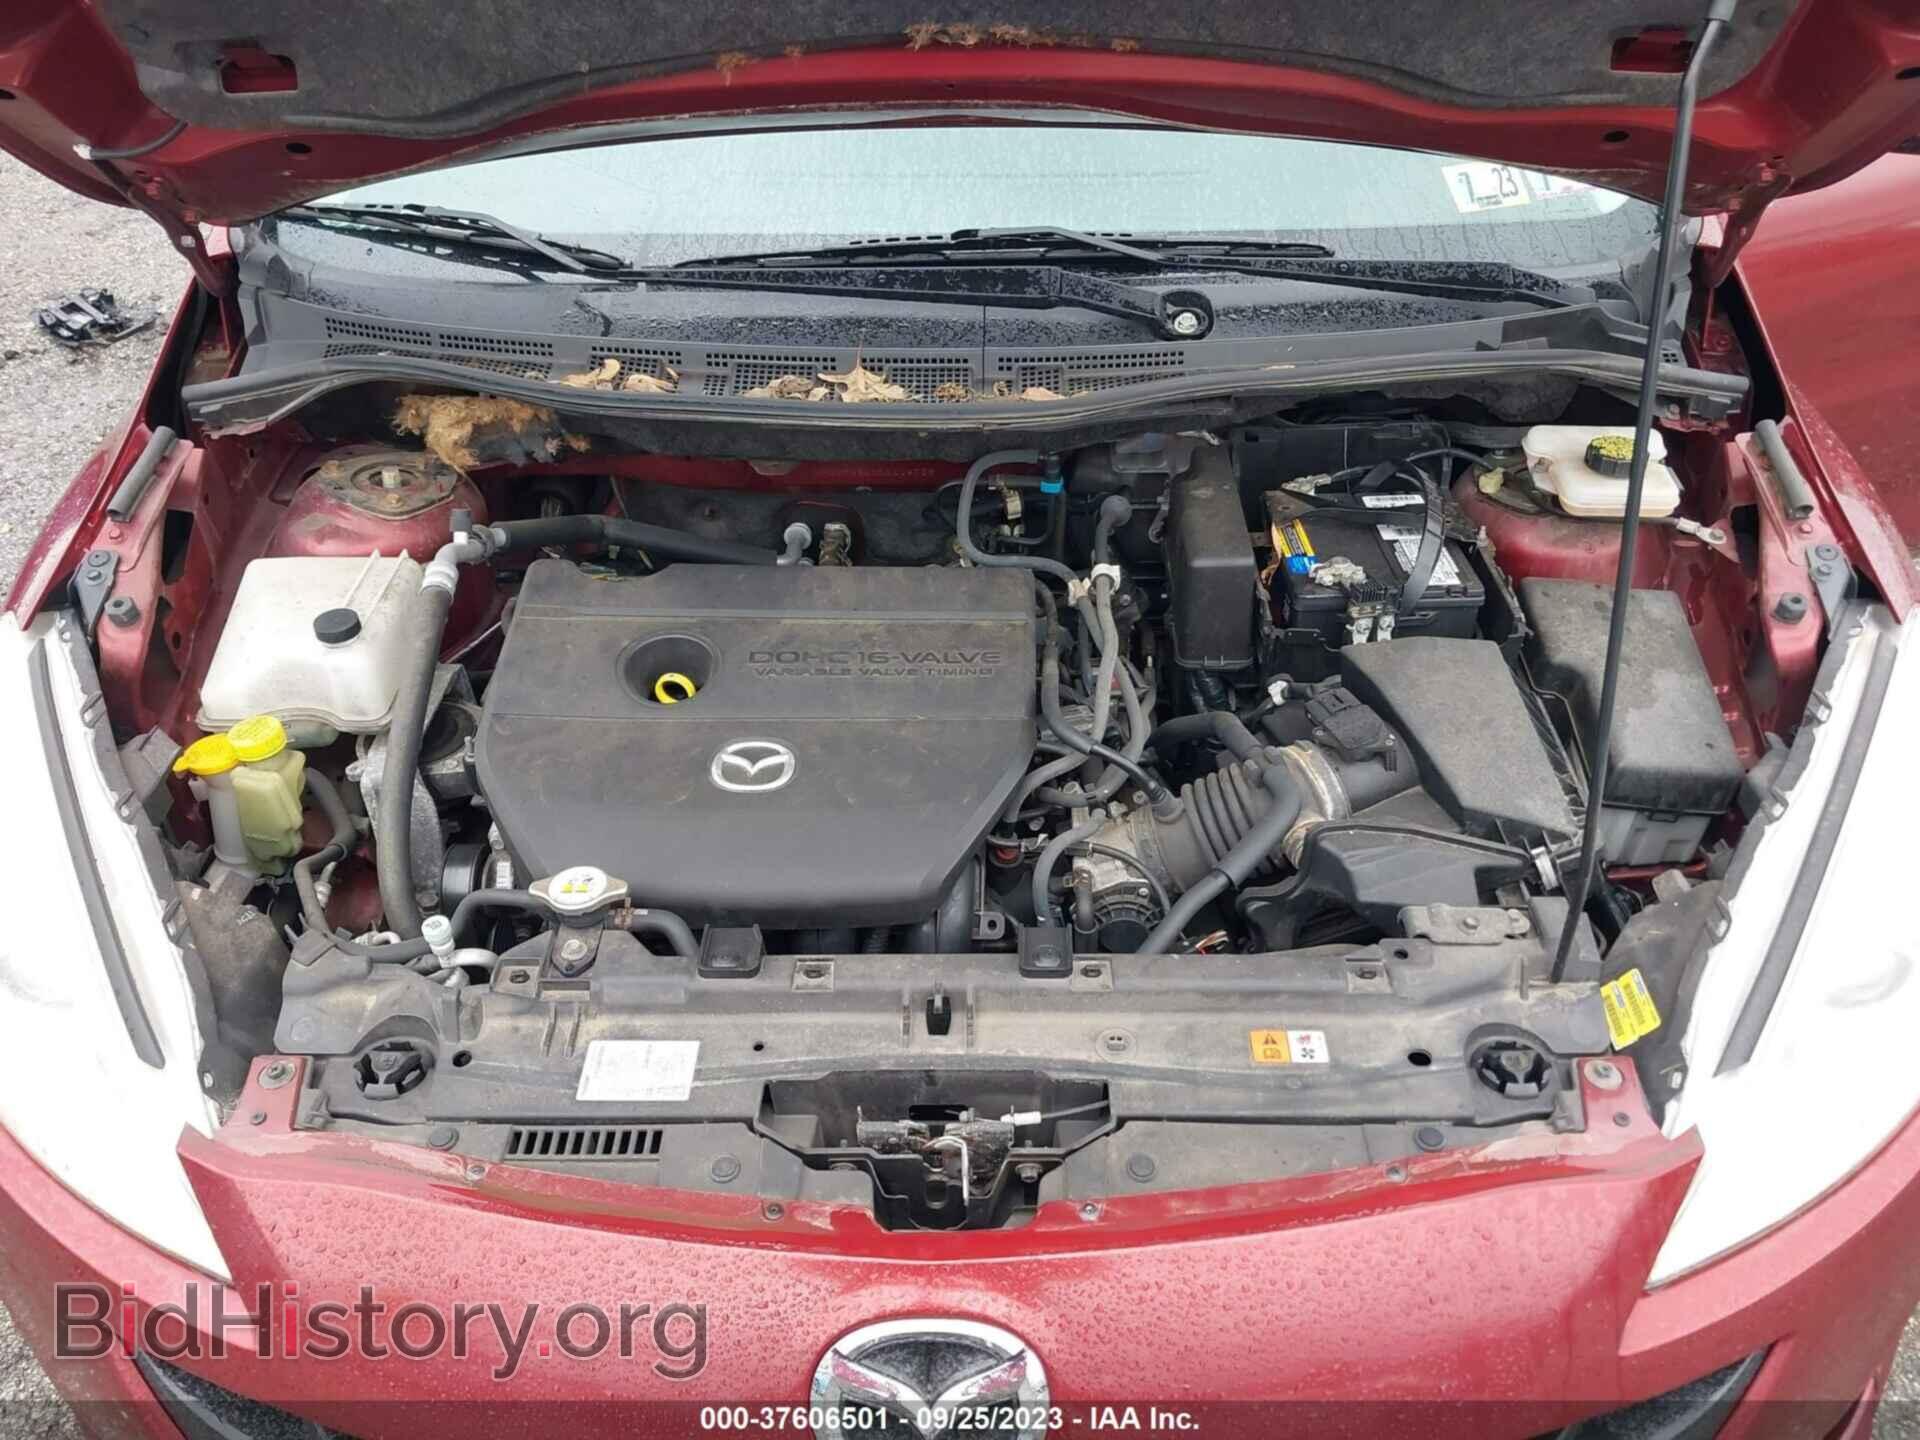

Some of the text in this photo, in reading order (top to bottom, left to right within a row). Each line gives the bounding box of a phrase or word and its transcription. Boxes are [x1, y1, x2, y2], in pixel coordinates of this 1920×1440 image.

[1492, 167, 1519, 198] 23
[749, 650, 1001, 664] DOHC 16-VALVE
[754, 666, 993, 677] VARIABLE VALVE TIMING
